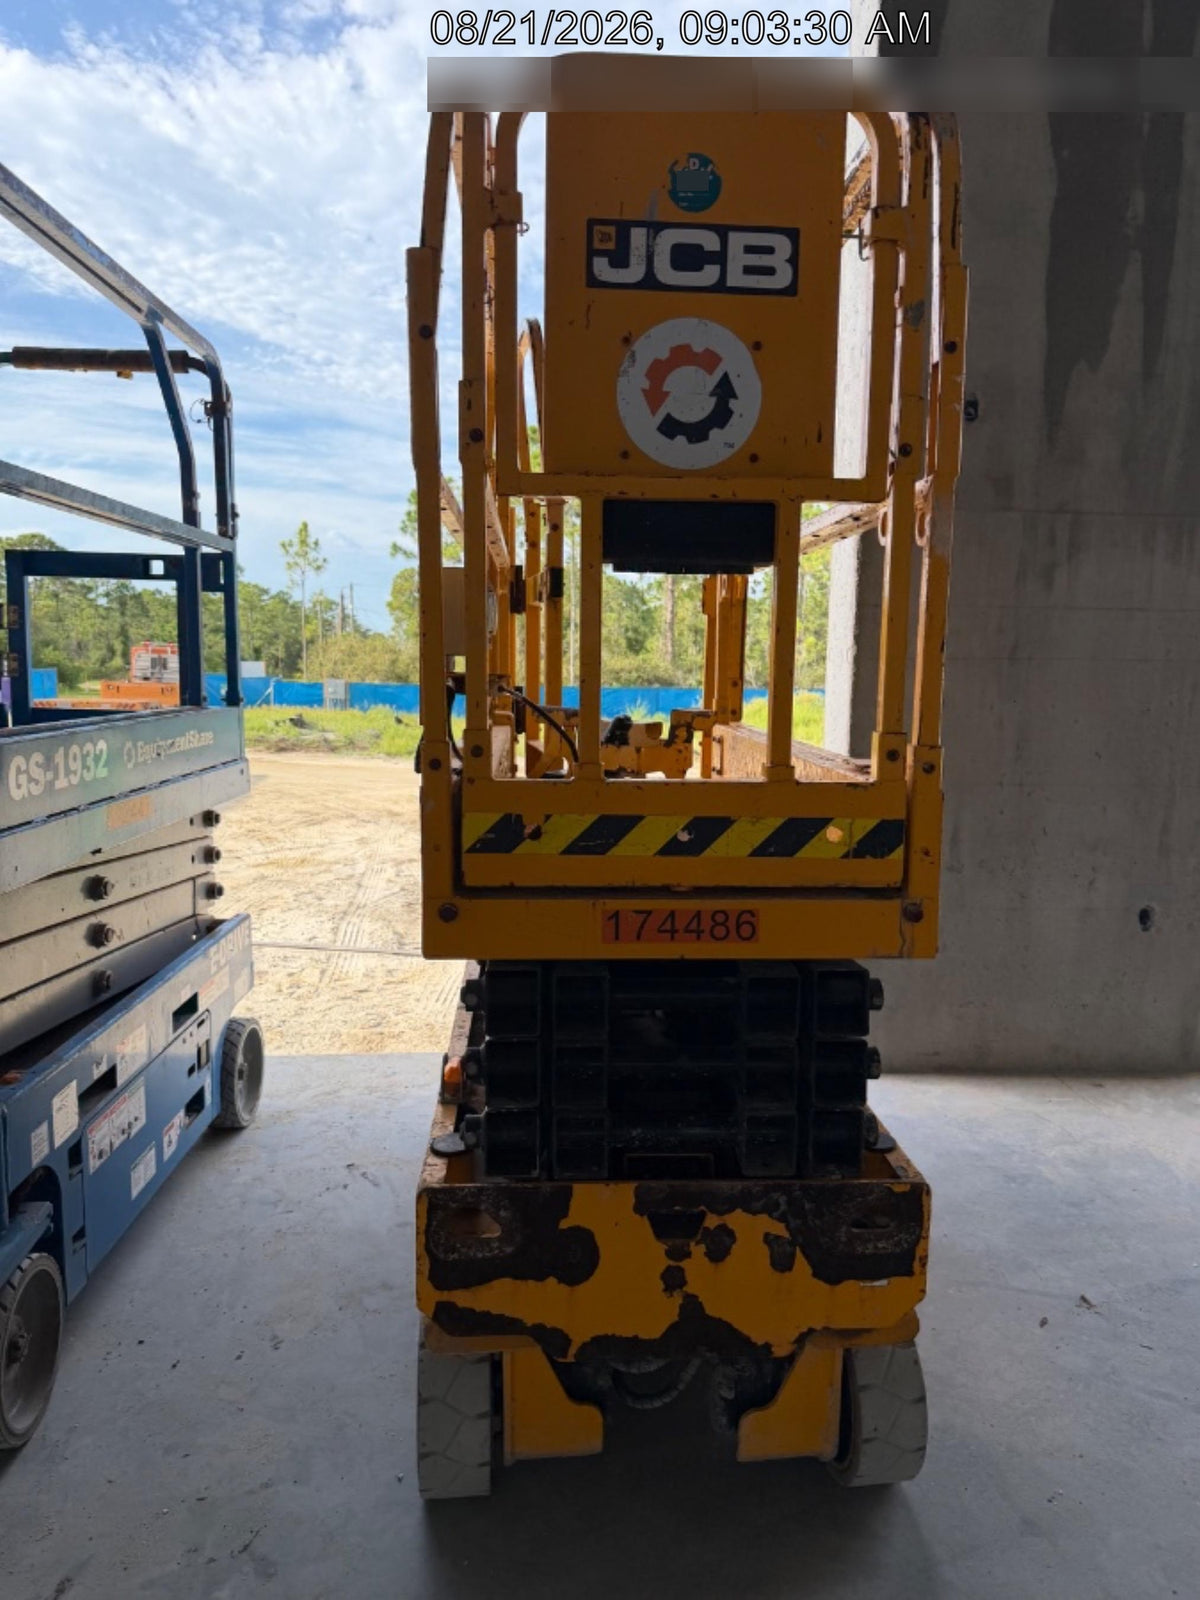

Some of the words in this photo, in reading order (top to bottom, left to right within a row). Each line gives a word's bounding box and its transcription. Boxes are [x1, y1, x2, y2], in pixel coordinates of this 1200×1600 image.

[592, 226, 794, 290] JCB
[8, 738, 109, 801] GS-1932
[606, 909, 757, 942] 174486
